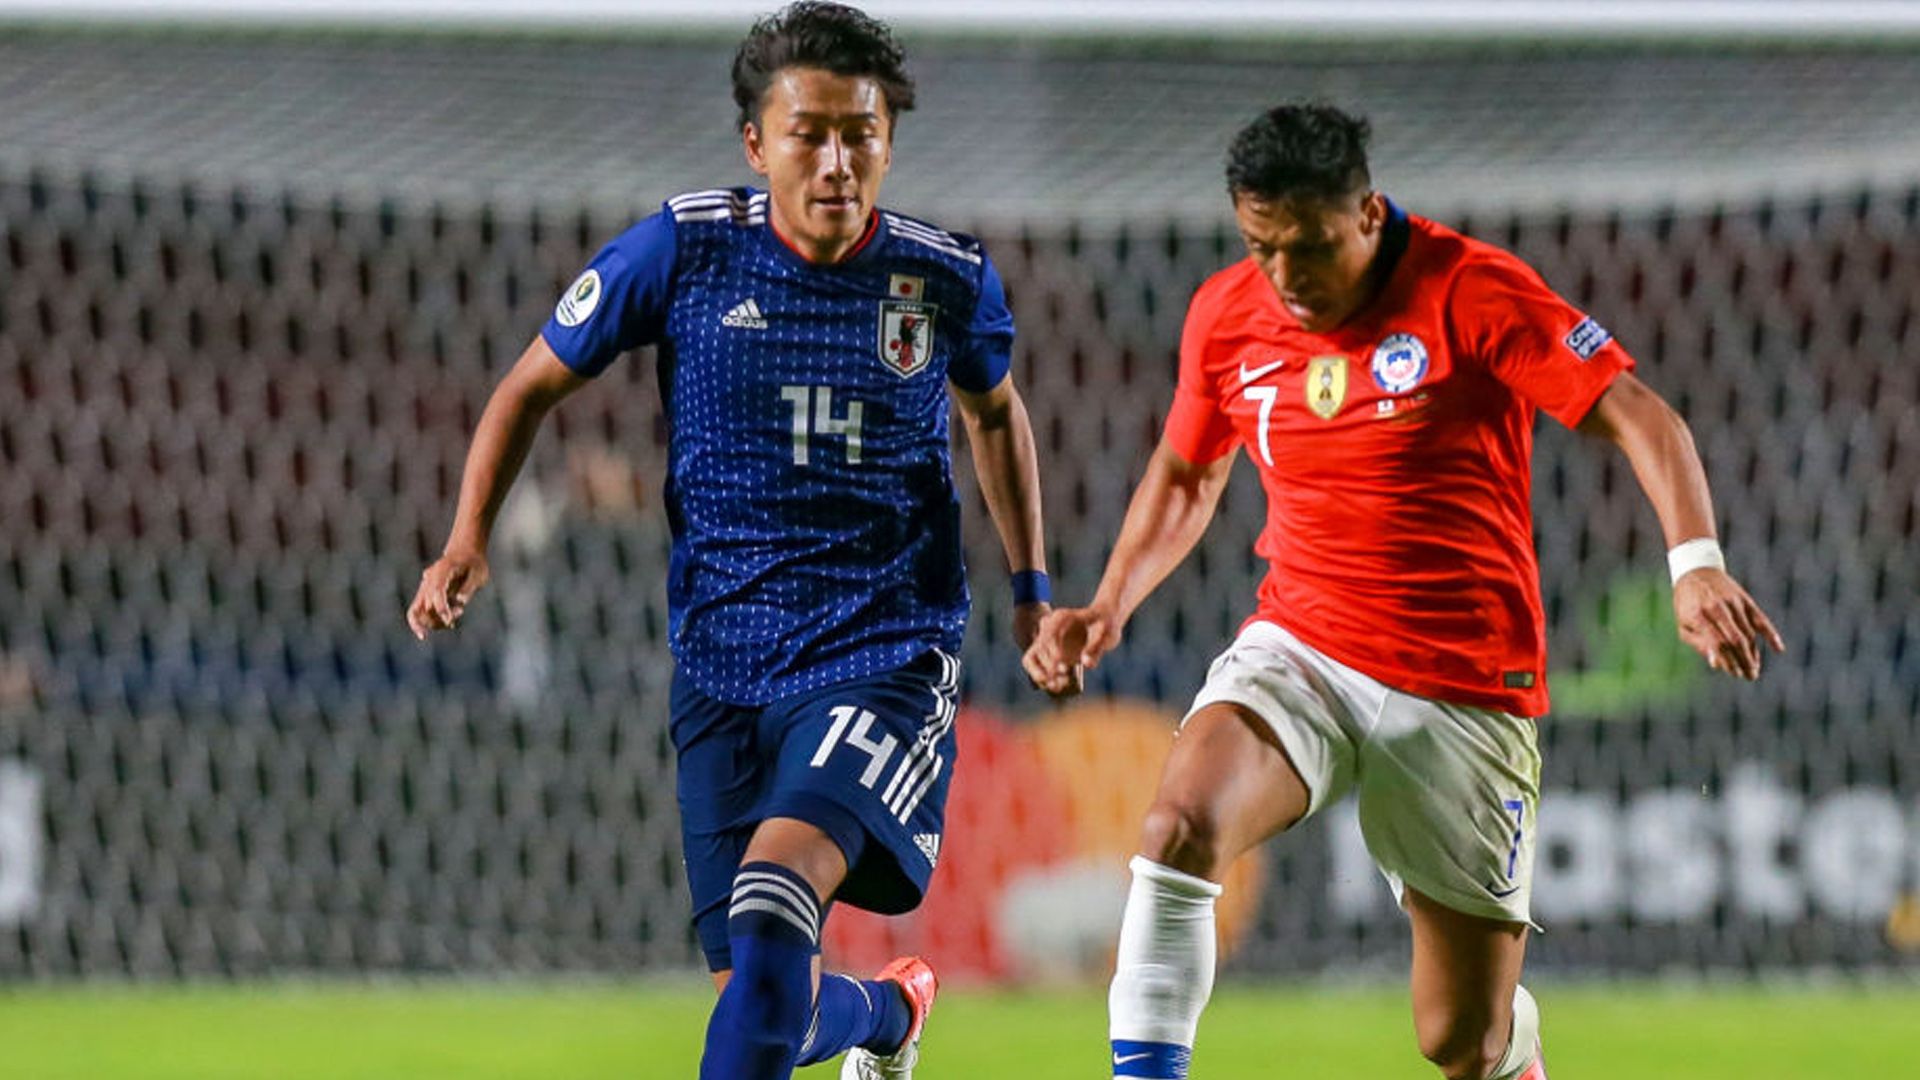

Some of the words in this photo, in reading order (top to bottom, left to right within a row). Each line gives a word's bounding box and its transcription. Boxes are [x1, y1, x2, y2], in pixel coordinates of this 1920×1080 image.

[722, 315, 768, 330] adidas
[781, 386, 864, 465] 14
[1243, 386, 1278, 467] 7
[810, 706, 898, 790] 14
[1504, 800, 1523, 879] 7
